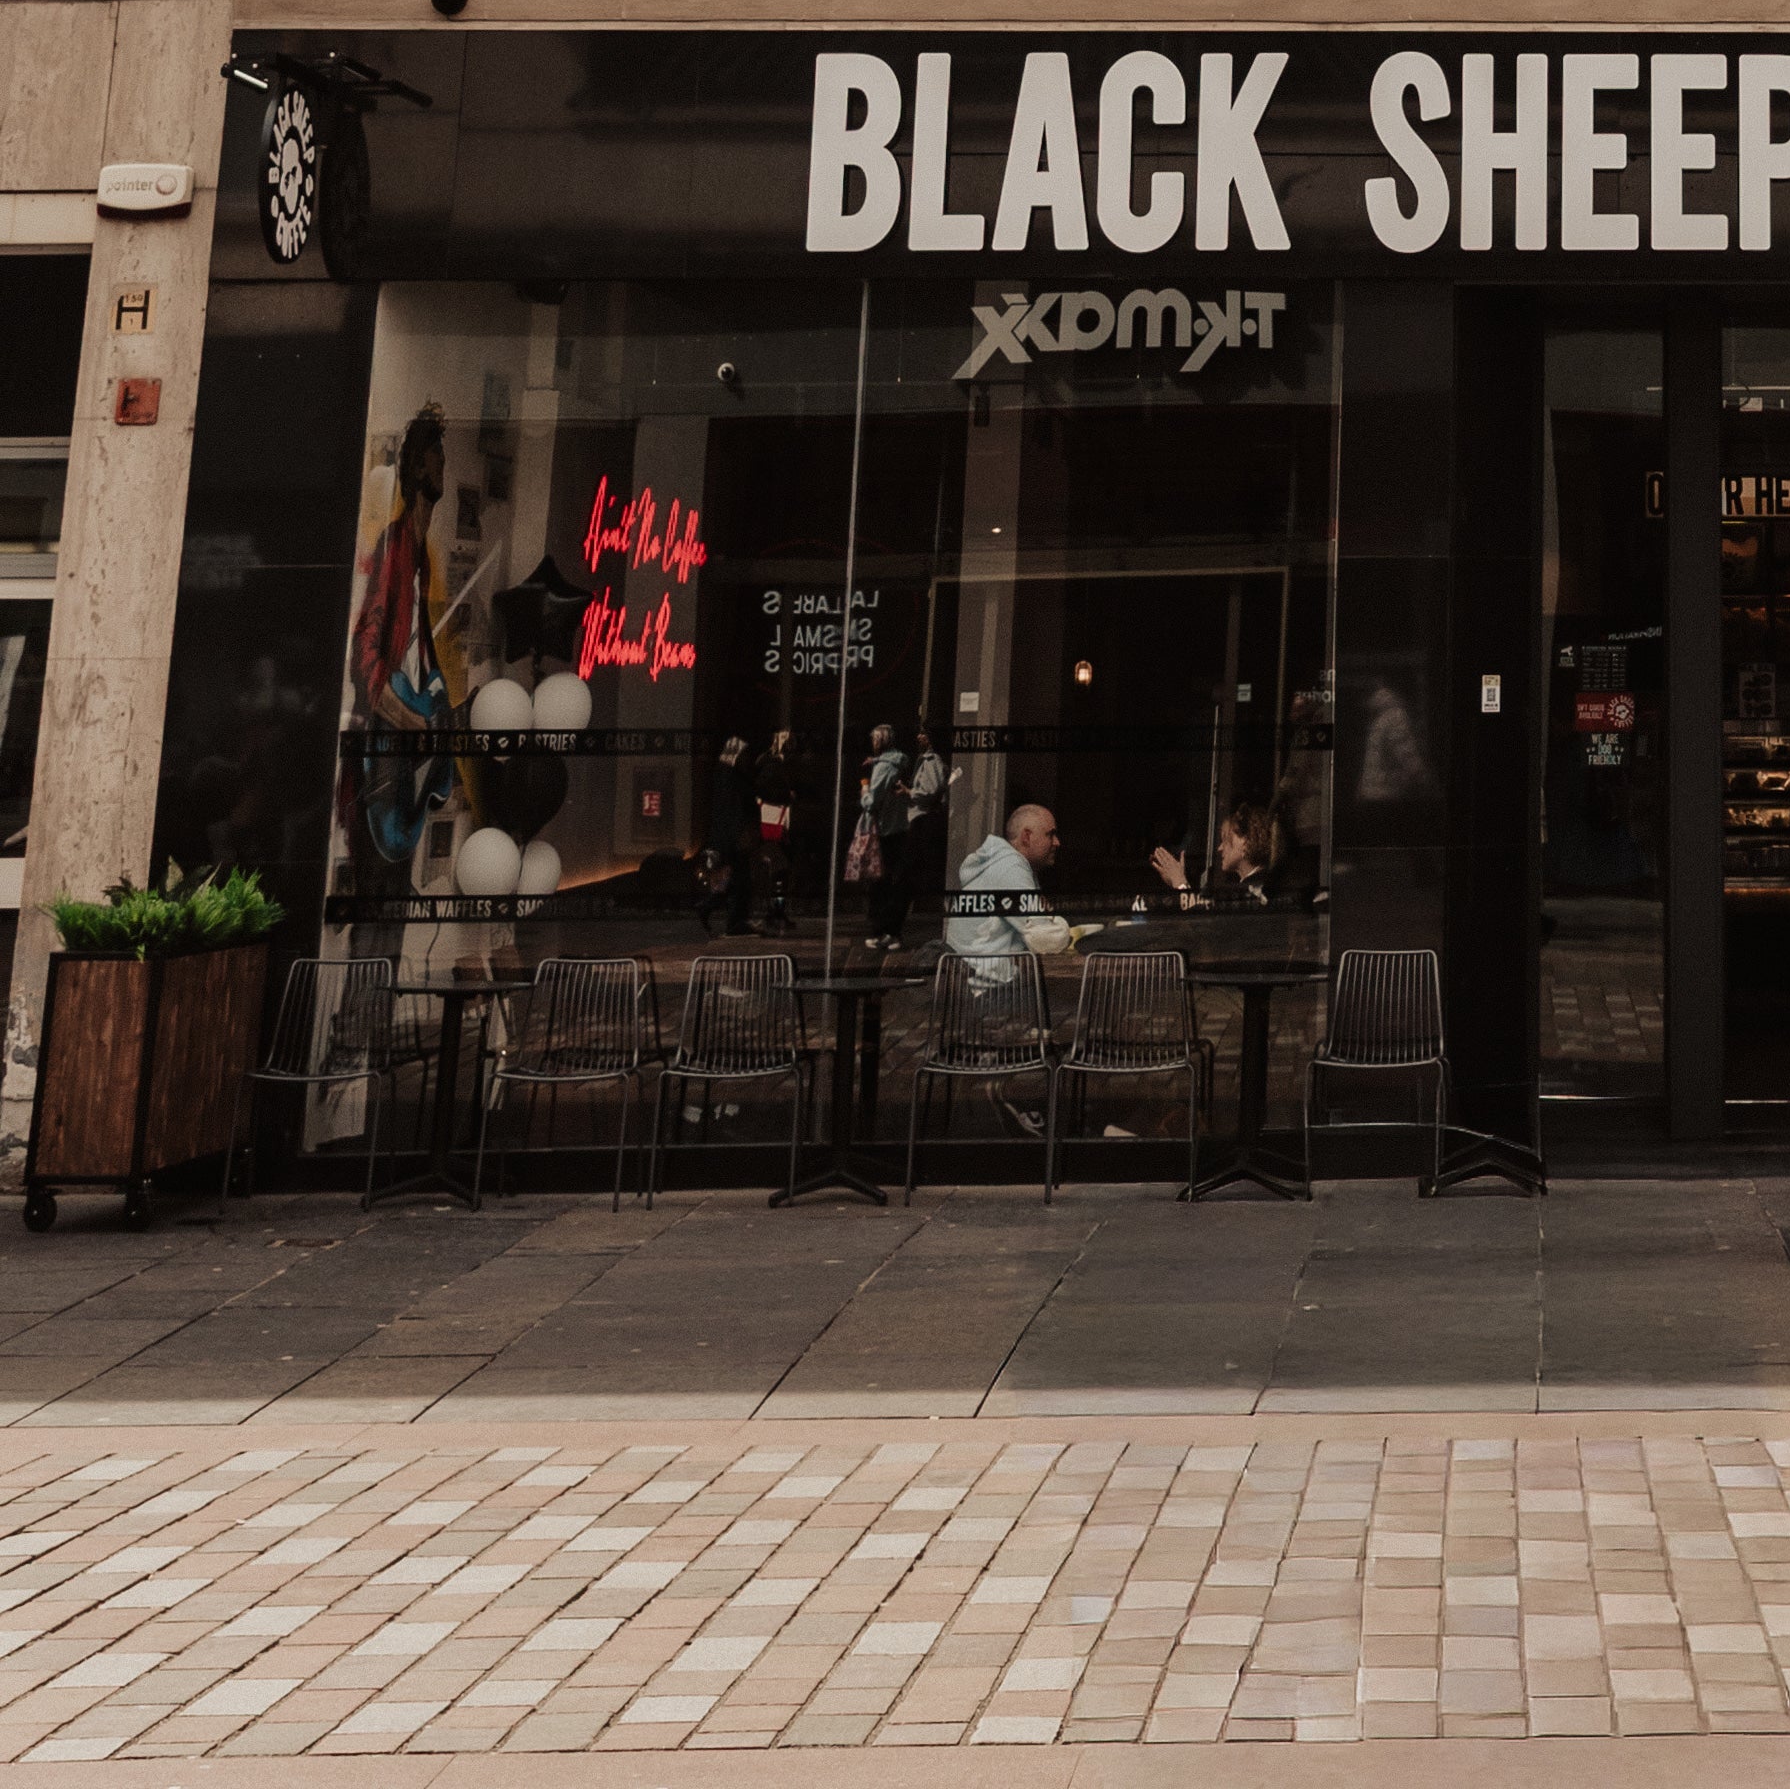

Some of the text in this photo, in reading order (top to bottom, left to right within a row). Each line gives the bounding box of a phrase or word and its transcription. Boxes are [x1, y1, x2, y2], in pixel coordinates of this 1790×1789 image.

[267, 90, 316, 184] BLACK SHEEP
[806, 51, 1290, 253] BLACK
[276, 195, 312, 260] COFFEE
[115, 290, 150, 330] H
[434, 900, 491, 918] WAFFLES
